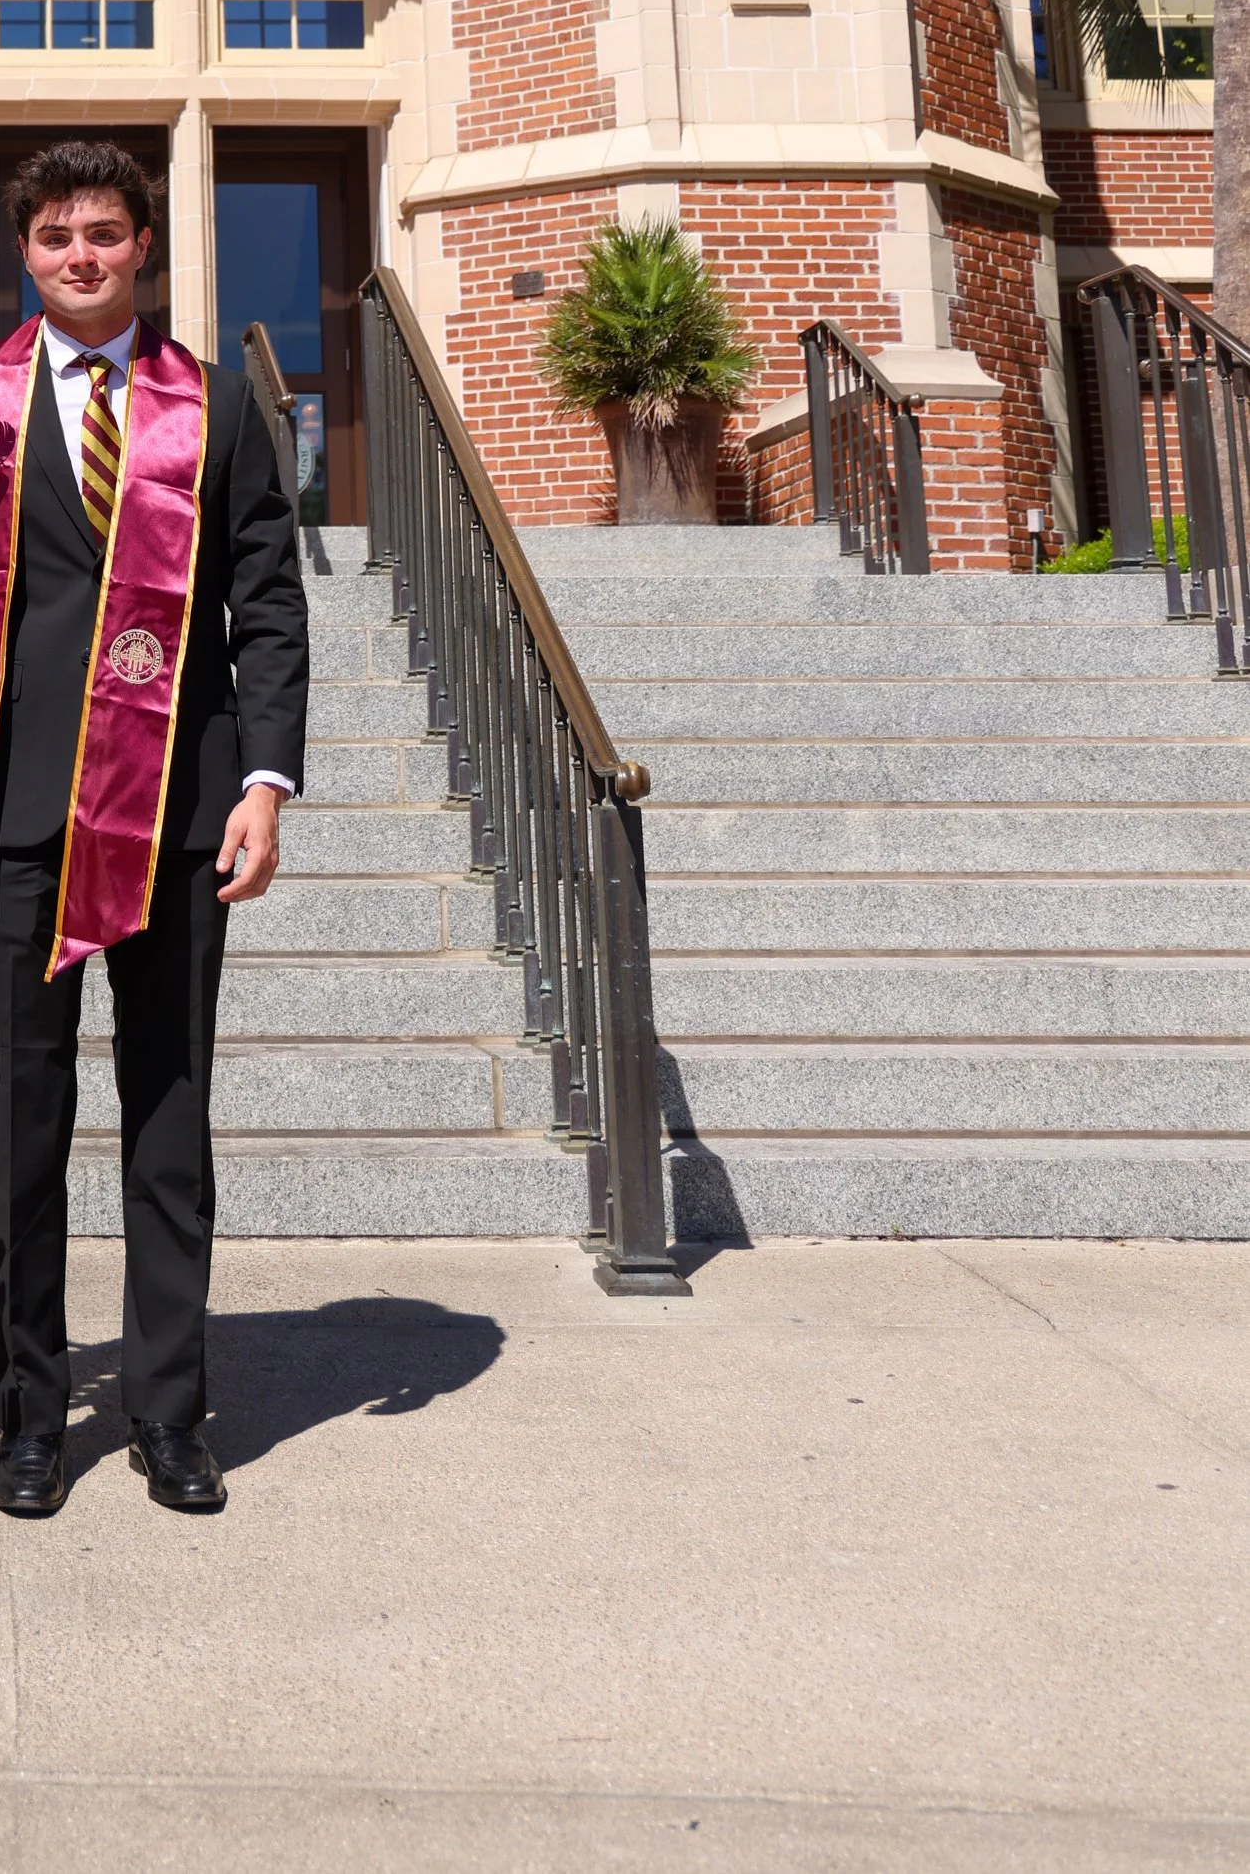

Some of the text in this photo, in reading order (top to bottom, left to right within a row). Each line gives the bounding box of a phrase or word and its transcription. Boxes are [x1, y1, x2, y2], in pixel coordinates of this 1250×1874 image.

[112, 632, 161, 675] FLORIDA STATE UNIVERSITY
